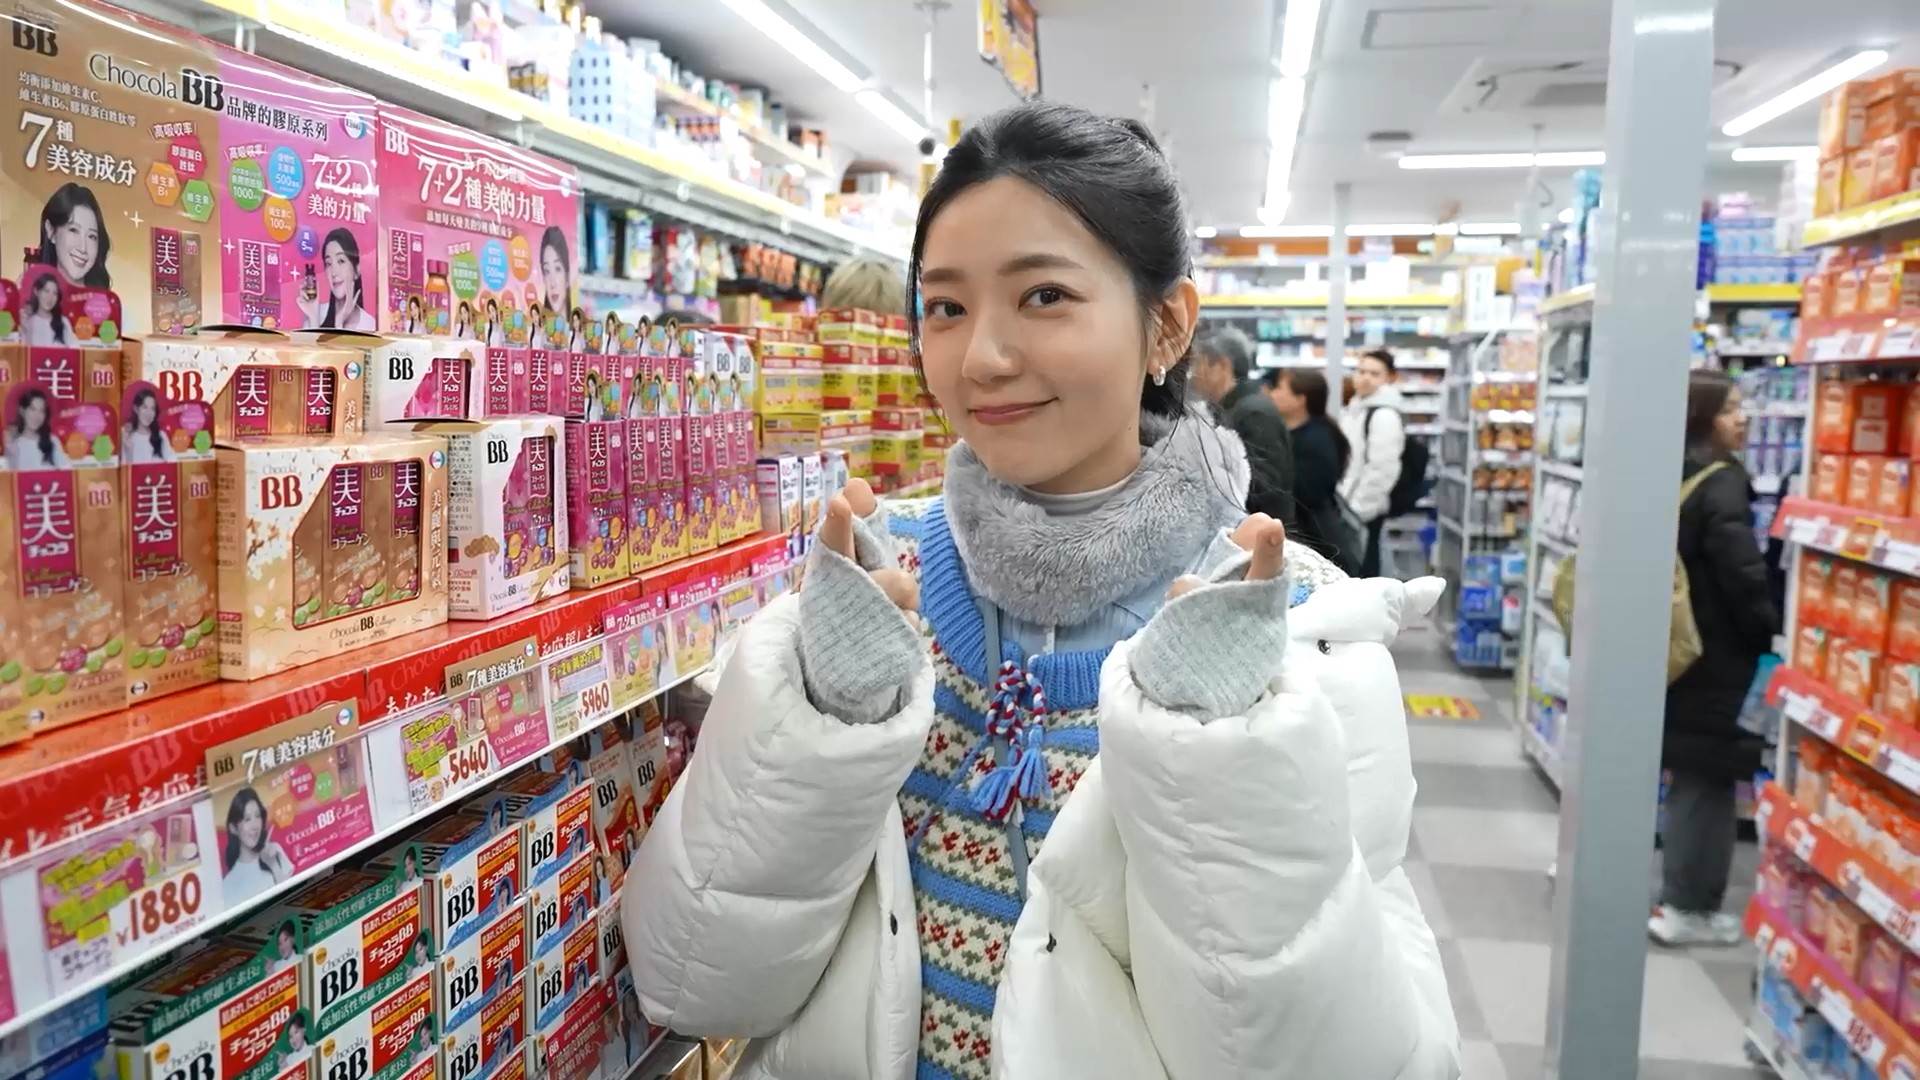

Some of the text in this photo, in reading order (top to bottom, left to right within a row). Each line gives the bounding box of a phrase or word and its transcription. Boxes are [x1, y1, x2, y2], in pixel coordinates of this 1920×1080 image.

[89, 53, 328, 142] Chocola BB 品牌的膠原系列
[385, 128, 410, 156] BB
[46, 143, 138, 187] 美容成分
[308, 193, 368, 224] 美的力量
[156, 235, 179, 268] 美
[244, 244, 261, 271] 美
[92, 371, 114, 387] BB
[280, 368, 293, 383] BB
[388, 357, 414, 380] BB
[489, 351, 508, 385] 美
[513, 361, 525, 375] BB
[530, 351, 548, 385] 美
[570, 355, 585, 386] 美
[159, 370, 204, 401] BB
[239, 406, 265, 417] チョコラ
[310, 406, 331, 417] チョコラ
[590, 426, 607, 459] 美
[630, 421, 644, 453] 美
[660, 420, 673, 450] 美
[487, 440, 508, 464] BB
[370, 465, 384, 479] BB
[89, 488, 111, 506] BB
[134, 474, 178, 531] 美
[191, 481, 209, 498] BB
[261, 474, 303, 510] BB
[397, 498, 418, 509] チョコラ
[22, 481, 75, 545] 美
[334, 505, 358, 517] チョコラ
[138, 529, 173, 543] チョコラ
[332, 532, 370, 550] コラーゲン
[135, 562, 192, 583] コラーゲン
[330, 626, 360, 641] Chocola
[360, 616, 375, 632] BB
[450, 673, 463, 688] BB
[576, 682, 609, 719] ¥5960
[514, 721, 526, 737] BB
[213, 756, 235, 777] BB
[241, 725, 336, 784] 7種美容成分
[443, 739, 489, 788] ¥5640
[637, 760, 656, 787] BB
[597, 779, 618, 808] BB
[286, 823, 318, 845] Chocola
[317, 808, 335, 829] BB
[531, 831, 554, 868] BB
[482, 857, 516, 891] チョコラBB
[116, 871, 201, 946] ¥1880
[447, 885, 475, 928] BB
[536, 901, 558, 940] BB
[369, 922, 414, 963] チョコラBB
[380, 945, 404, 969] プラス
[485, 934, 520, 970] チョコラBB
[603, 924, 621, 958] BB
[320, 957, 359, 1010] BB
[450, 965, 478, 1010] BB
[540, 969, 562, 1010] BB
[228, 1005, 291, 1057] チョコラBB
[379, 1007, 425, 1050] チョコラBB
[485, 1007, 520, 1046] チョコラBB
[243, 1032, 277, 1063] プラス
[450, 1042, 478, 1080] BB
